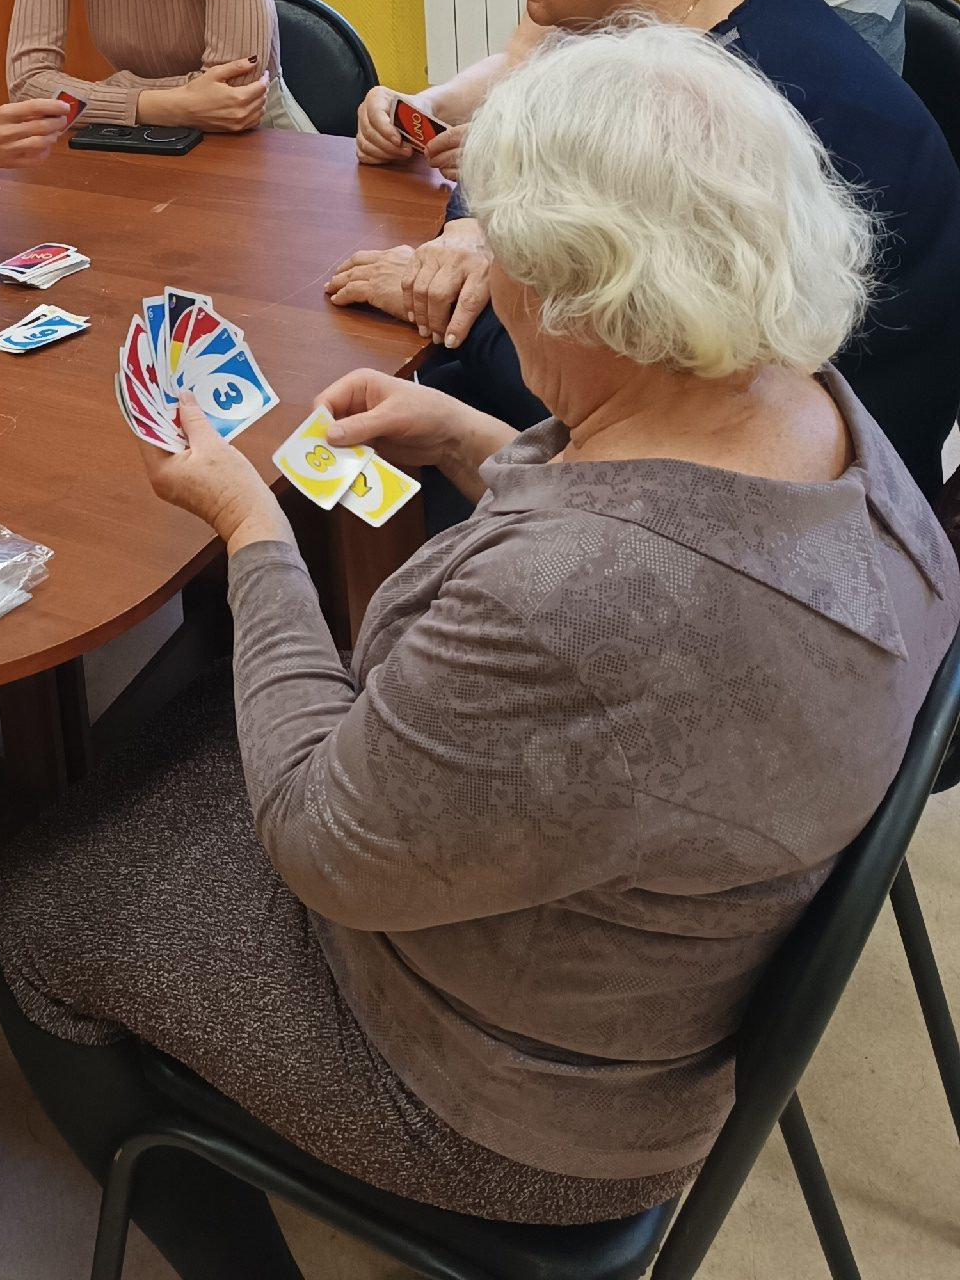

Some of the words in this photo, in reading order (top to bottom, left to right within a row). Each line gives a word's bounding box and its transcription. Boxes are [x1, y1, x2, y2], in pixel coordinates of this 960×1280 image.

[411, 112, 424, 141] UNO
[20, 252, 53, 260] UNO
[212, 381, 244, 410] 3
[305, 444, 337, 473] 8
